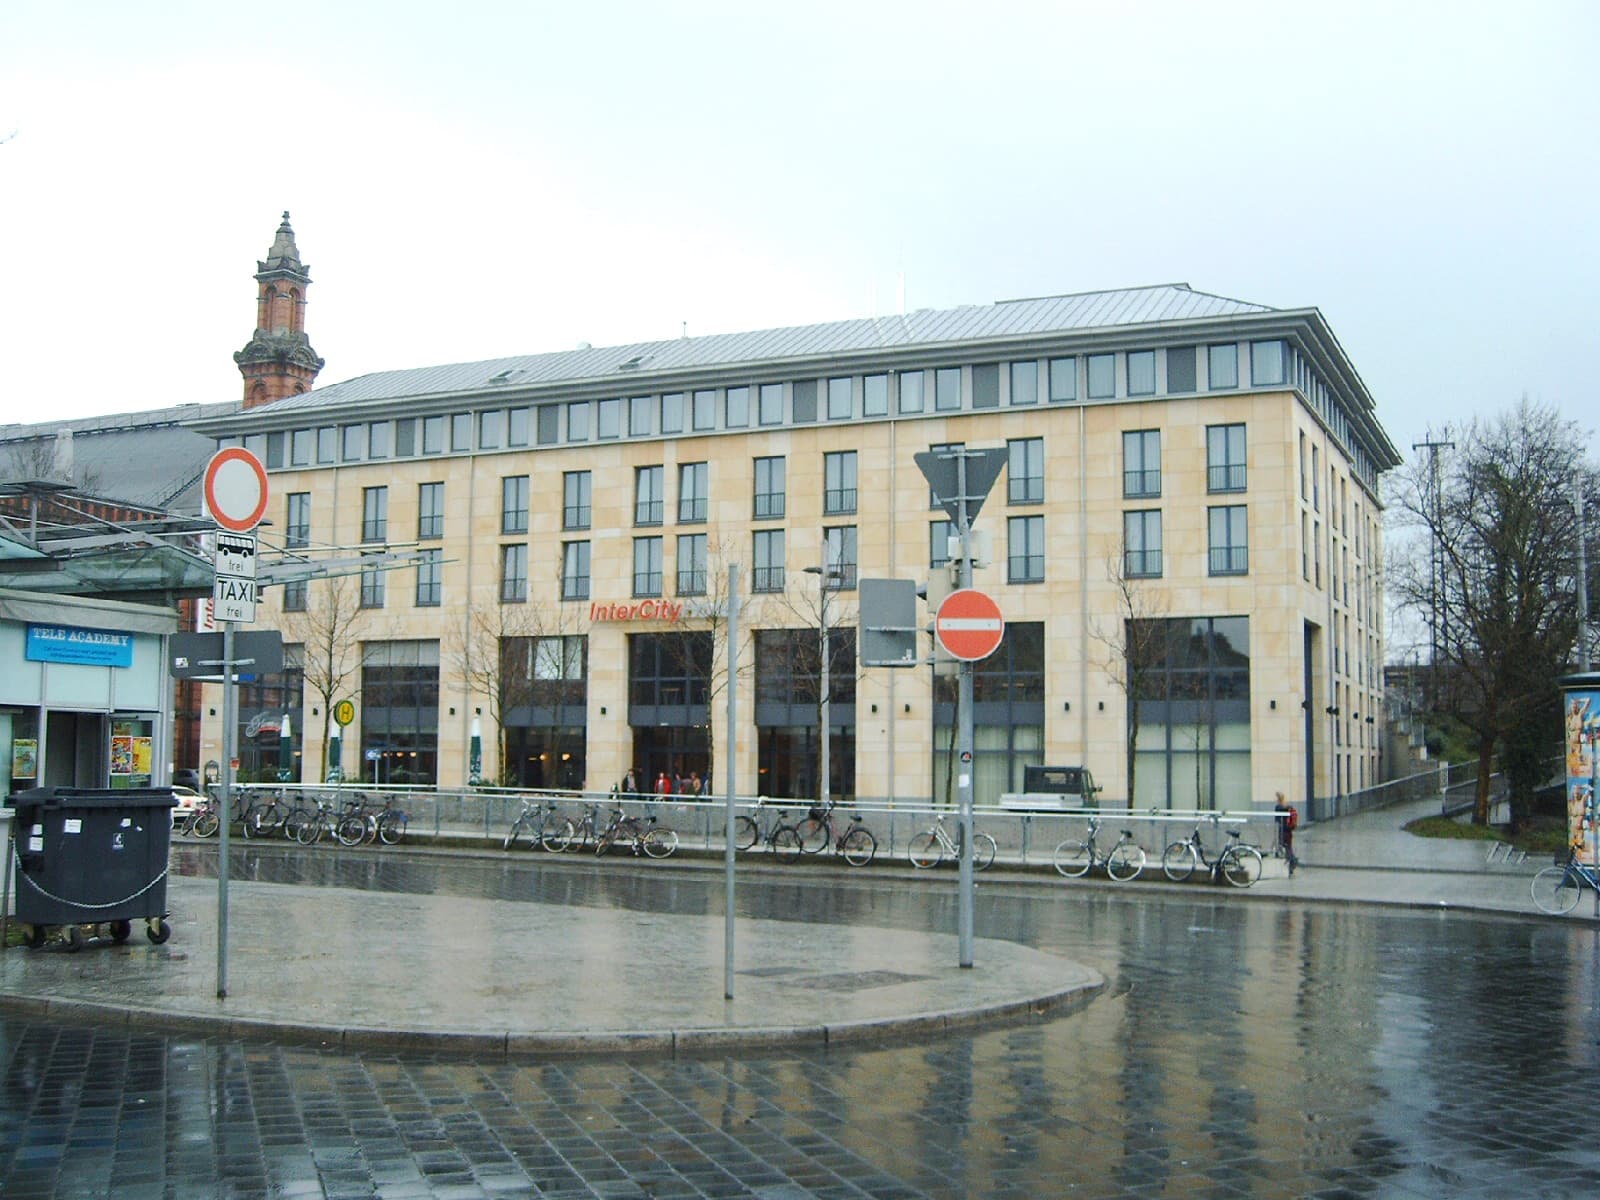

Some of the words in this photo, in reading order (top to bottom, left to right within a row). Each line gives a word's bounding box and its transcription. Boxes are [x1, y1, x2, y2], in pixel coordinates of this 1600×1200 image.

[228, 560, 244, 572] frei
[217, 580, 254, 602] TAXI
[226, 606, 243, 618] frei
[589, 600, 683, 623] InterCity
[32, 627, 66, 641] TELE
[68, 631, 129, 647] ACADEMY
[340, 703, 351, 723] H
